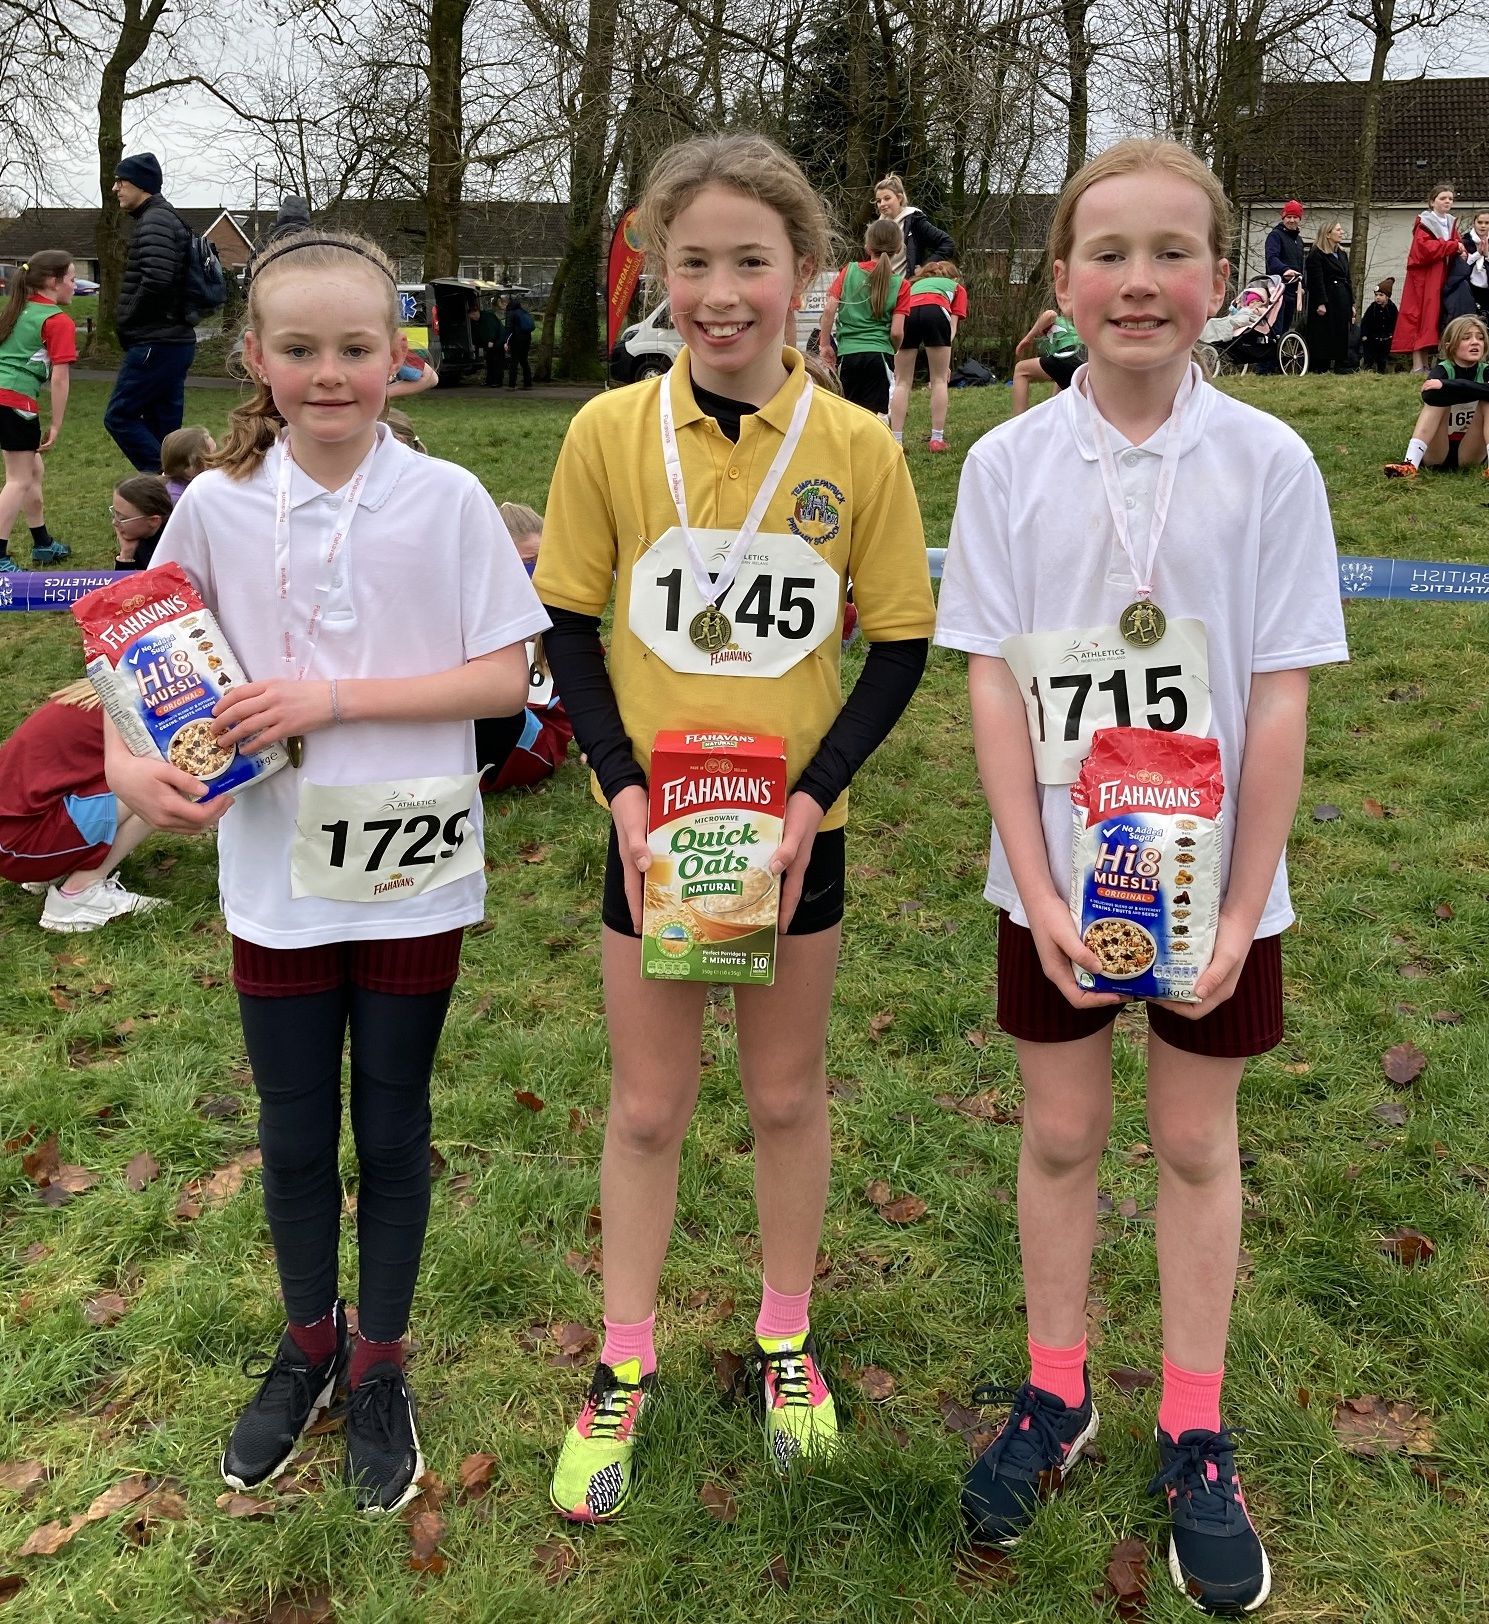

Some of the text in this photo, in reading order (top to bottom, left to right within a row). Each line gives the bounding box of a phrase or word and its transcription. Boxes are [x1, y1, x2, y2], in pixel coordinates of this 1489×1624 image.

[611, 256, 633, 305] RIVERDALE
[791, 479, 846, 505] TEMPLEPATRICK
[813, 525, 840, 546] SCHOOL
[45, 577, 113, 587] ATHLETICS
[99, 594, 188, 651] FLAHAVAN'S
[141, 644, 154, 654] No
[151, 642, 174, 656] Sugar
[710, 650, 752, 666] FLAHAVAN'S
[1081, 648, 1125, 659] ATHLETICS
[134, 649, 195, 697] Hi8
[144, 672, 202, 710] MUESLI
[162, 691, 200, 714] ORIGINAL
[1030, 664, 1188, 742] 1715
[684, 734, 755, 745] FLAHAVAN'S
[397, 799, 437, 808] ATHLETICS
[662, 776, 772, 816] FLAHAVAN'S
[1098, 779, 1201, 813] FLAHAVAN'S
[694, 815, 740, 825] MICROWAVE
[321, 808, 471, 872] 1729
[669, 823, 760, 856] Quick
[1122, 825, 1164, 837] No Added
[1128, 833, 1156, 843] Sugar
[678, 850, 749, 880] Oats
[1095, 842, 1162, 878] Hi8
[373, 878, 414, 895] FLAHAVAN'S
[688, 882, 737, 895] NATURAL
[1094, 871, 1160, 892] MUESLI
[1104, 890, 1147, 901] ORIGINAL
[702, 956, 747, 965] 2 MINUTES
[752, 957, 767, 969] 10
